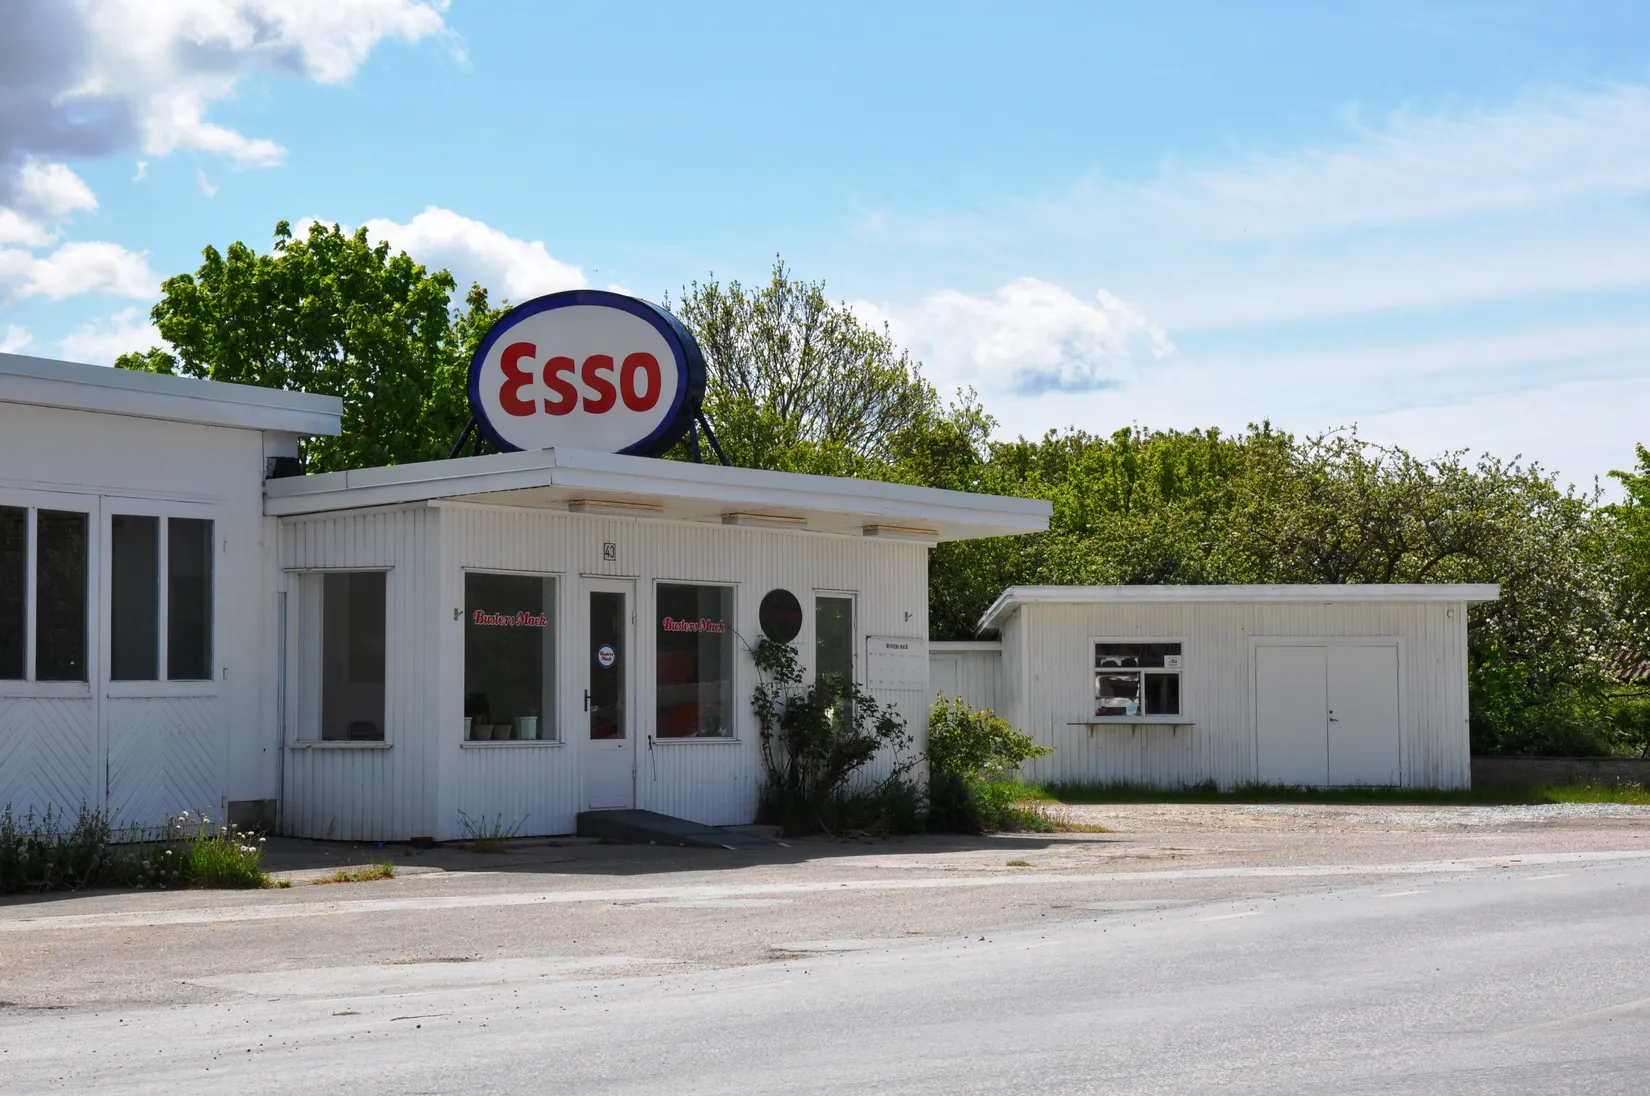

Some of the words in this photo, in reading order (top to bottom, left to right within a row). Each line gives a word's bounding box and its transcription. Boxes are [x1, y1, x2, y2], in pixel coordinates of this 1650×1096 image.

[605, 545, 615, 557] 43
[474, 610, 515, 626] Busters
[515, 610, 547, 627] Mack
[663, 617, 699, 632] Busters
[699, 618, 725, 632] Mack
